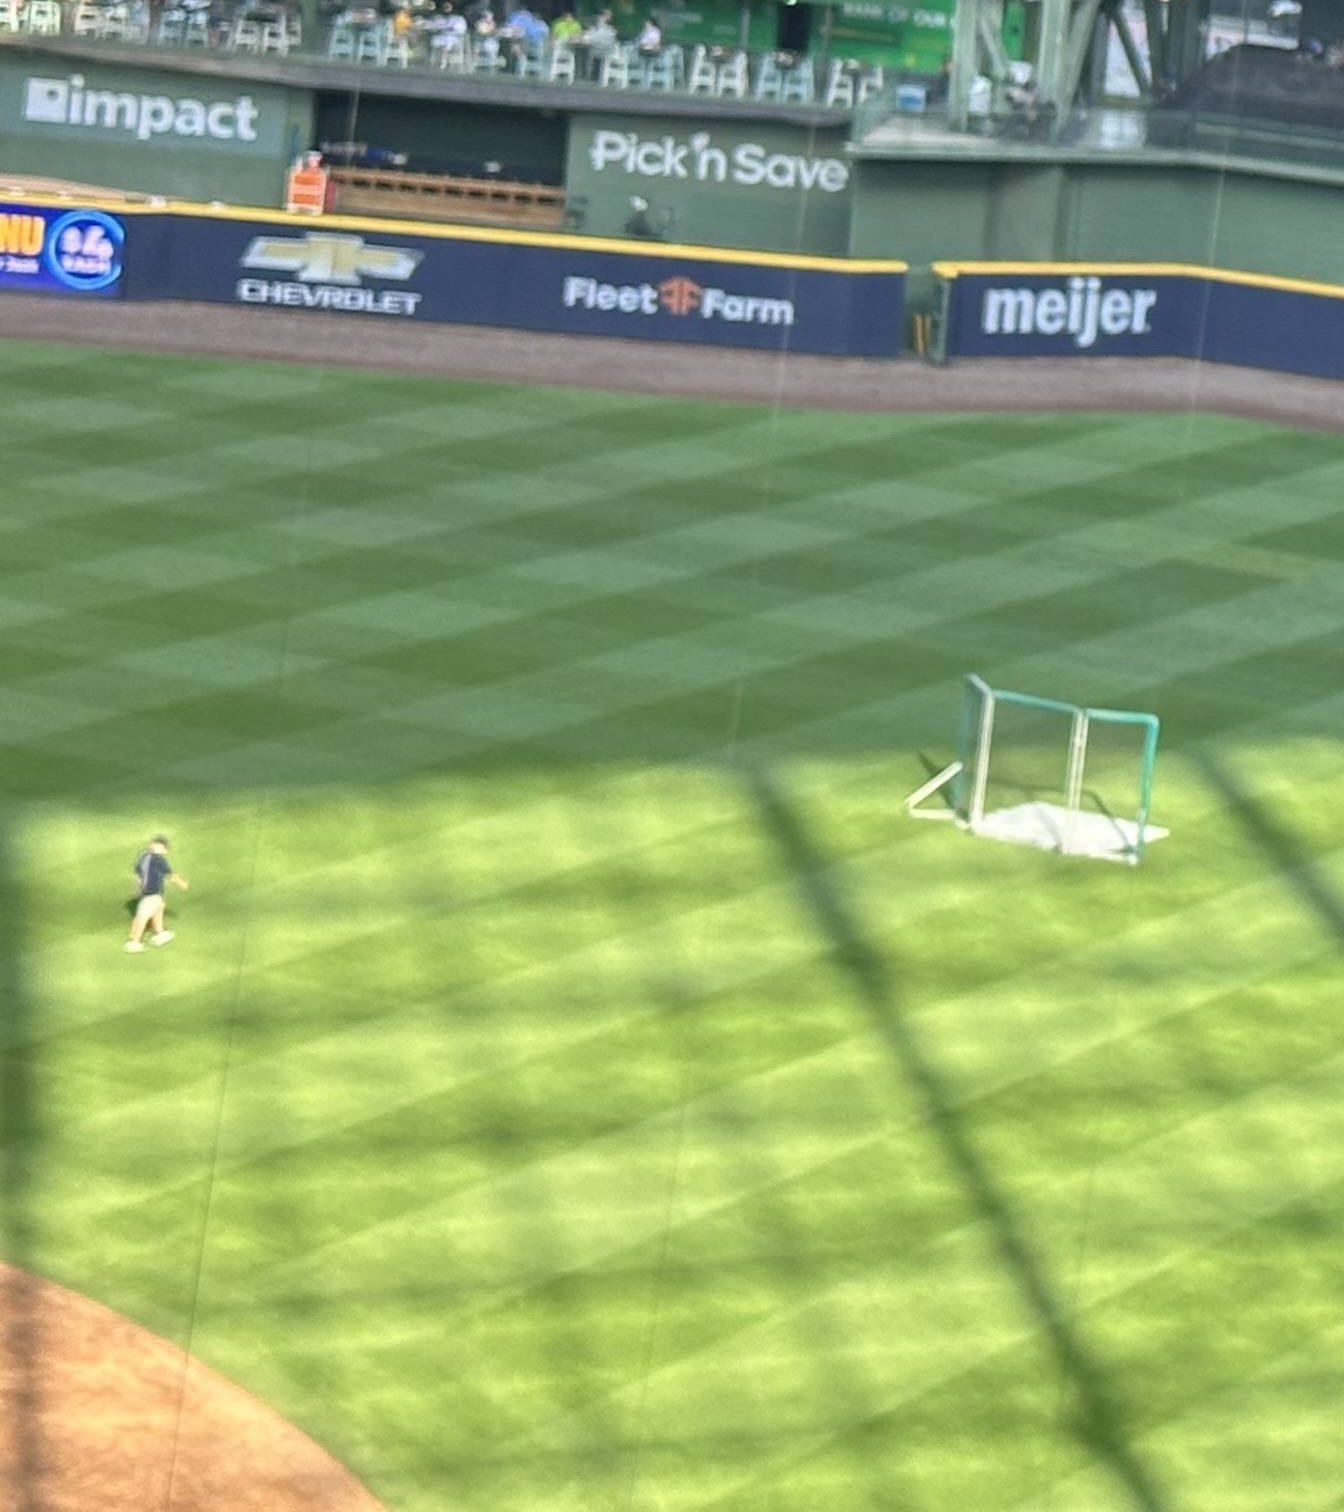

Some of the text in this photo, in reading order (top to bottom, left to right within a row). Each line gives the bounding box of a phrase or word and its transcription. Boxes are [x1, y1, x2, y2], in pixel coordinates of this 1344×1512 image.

[69, 74, 258, 142] impact
[590, 129, 849, 192] Pick 'n Save
[236, 279, 422, 316] CHEVROLET
[564, 276, 794, 325] Fleet Farm
[983, 276, 1156, 347] meijer
